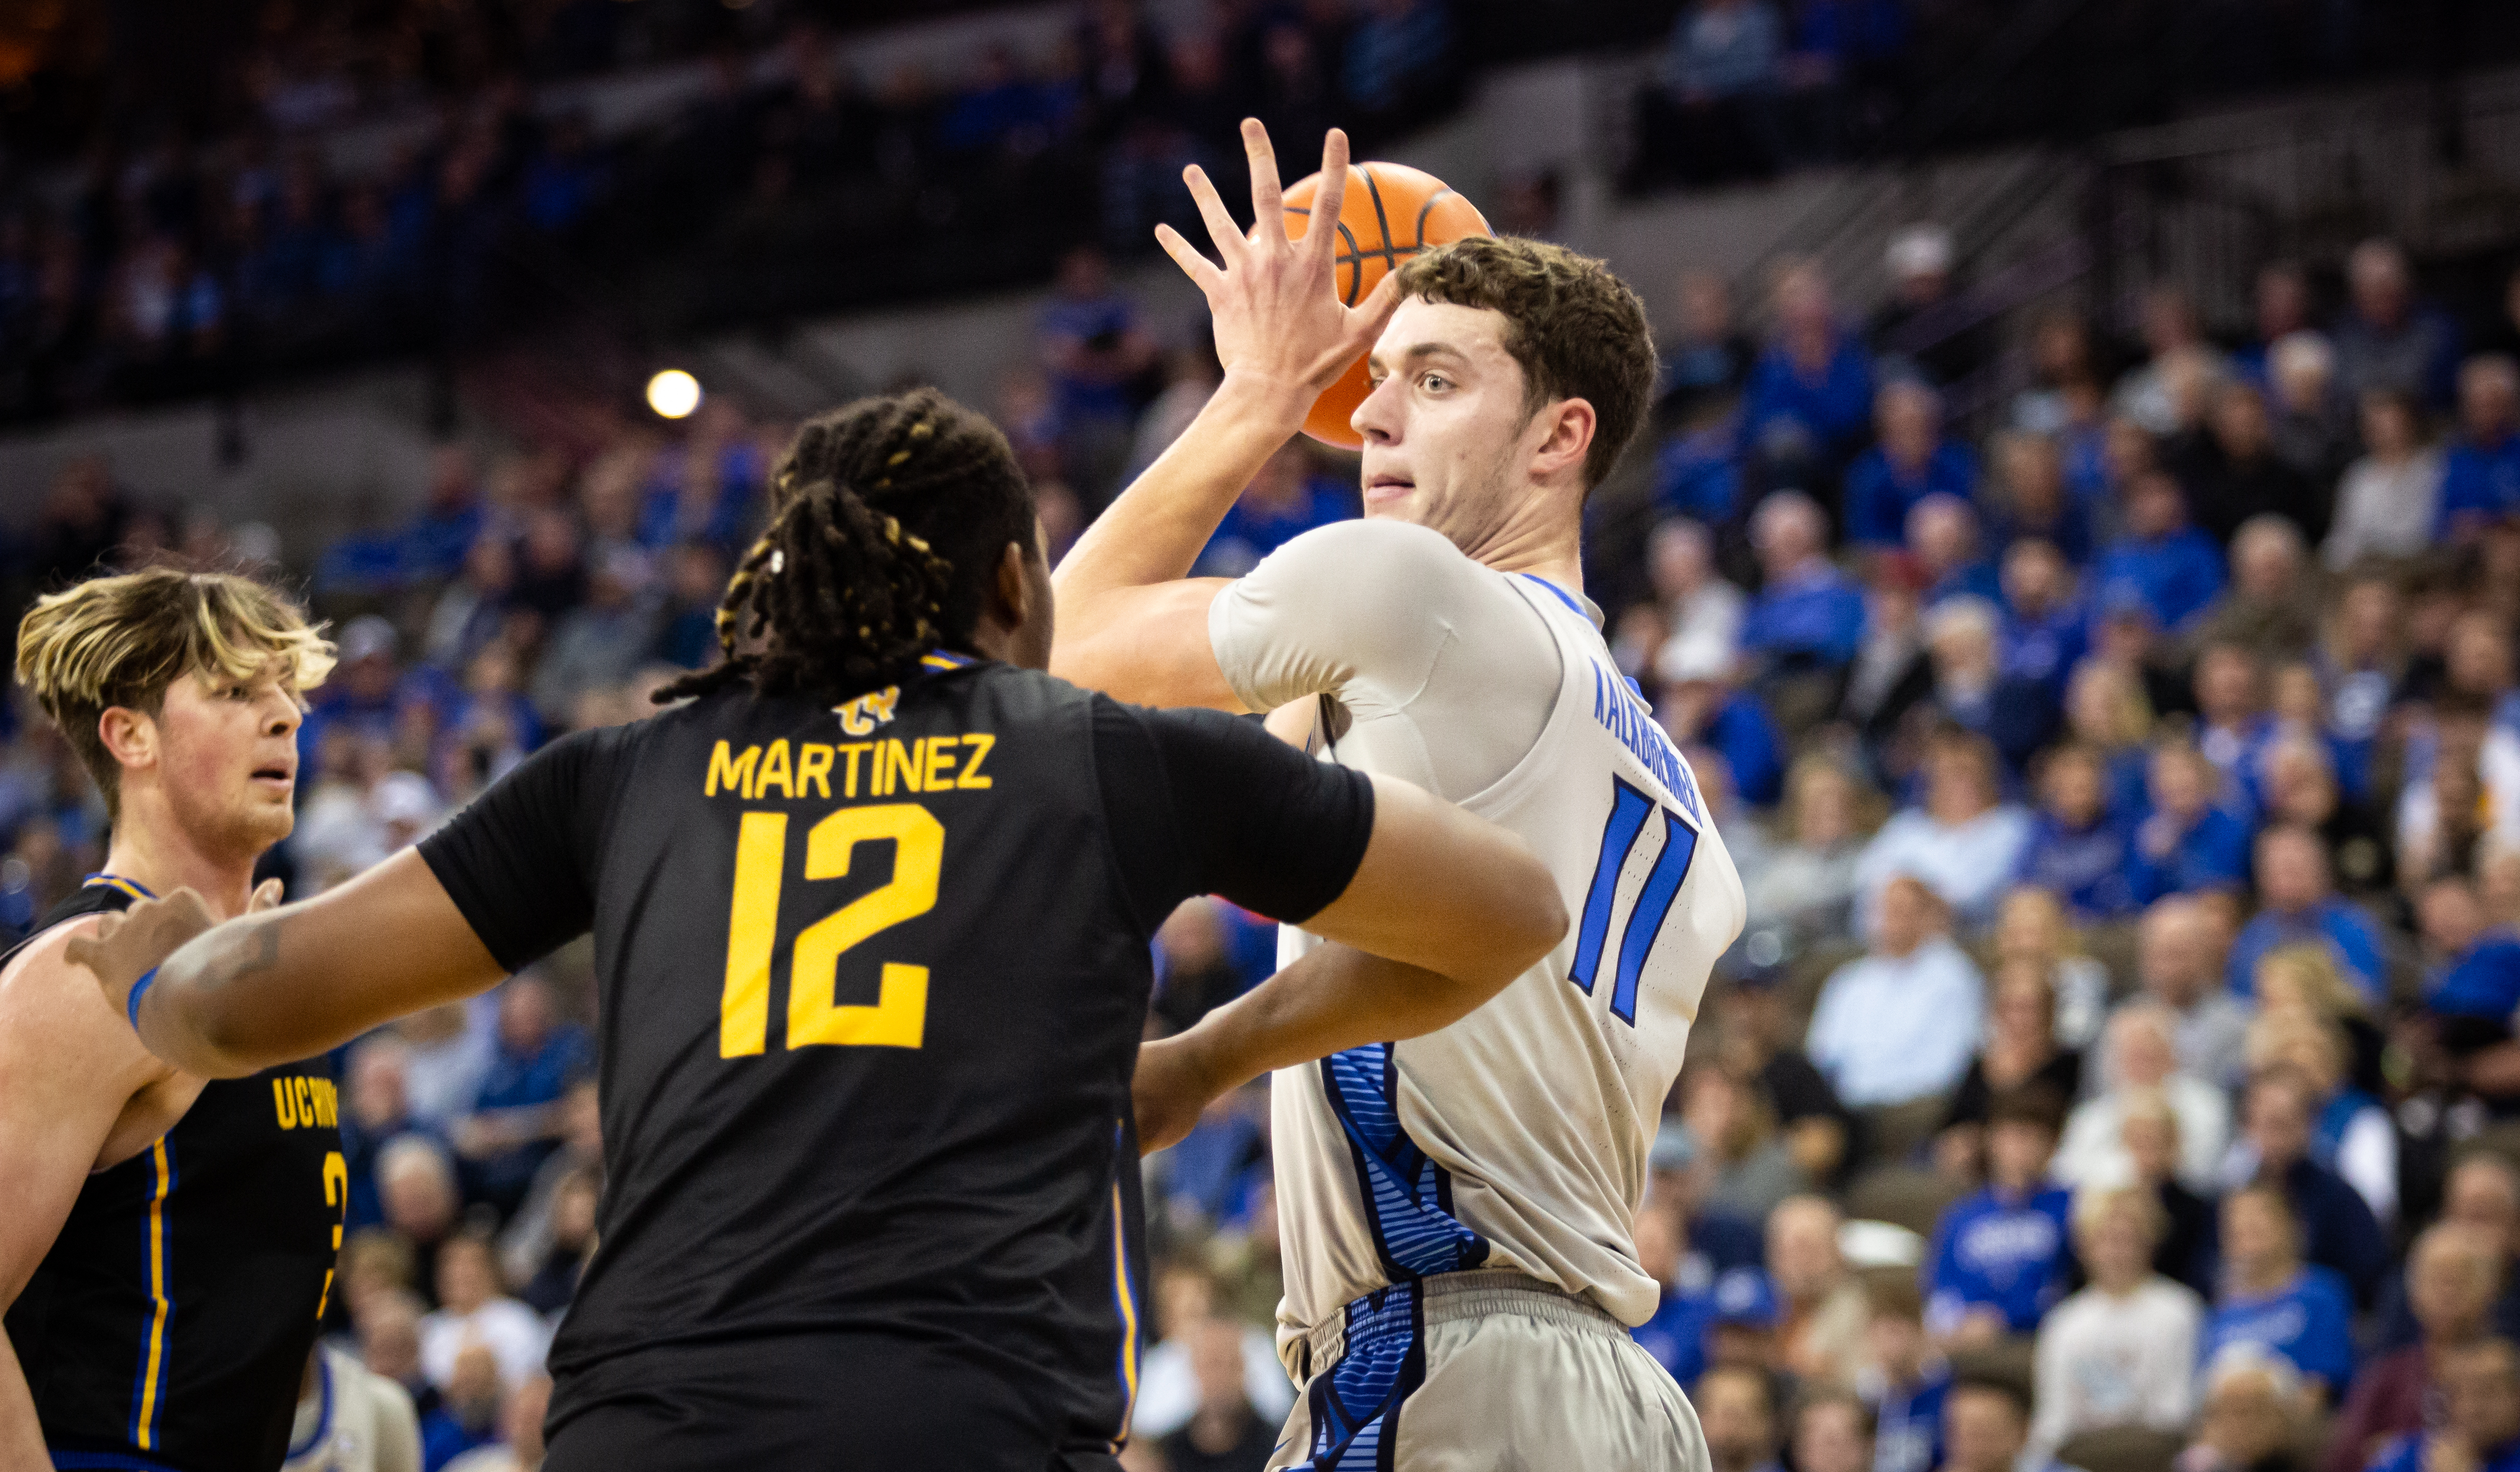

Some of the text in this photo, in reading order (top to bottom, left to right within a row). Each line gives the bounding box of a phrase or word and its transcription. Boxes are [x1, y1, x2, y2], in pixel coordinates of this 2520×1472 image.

[704, 733, 996, 799] MARTINEZ
[719, 803, 946, 1059] 12
[1567, 771, 1699, 1029] 11
